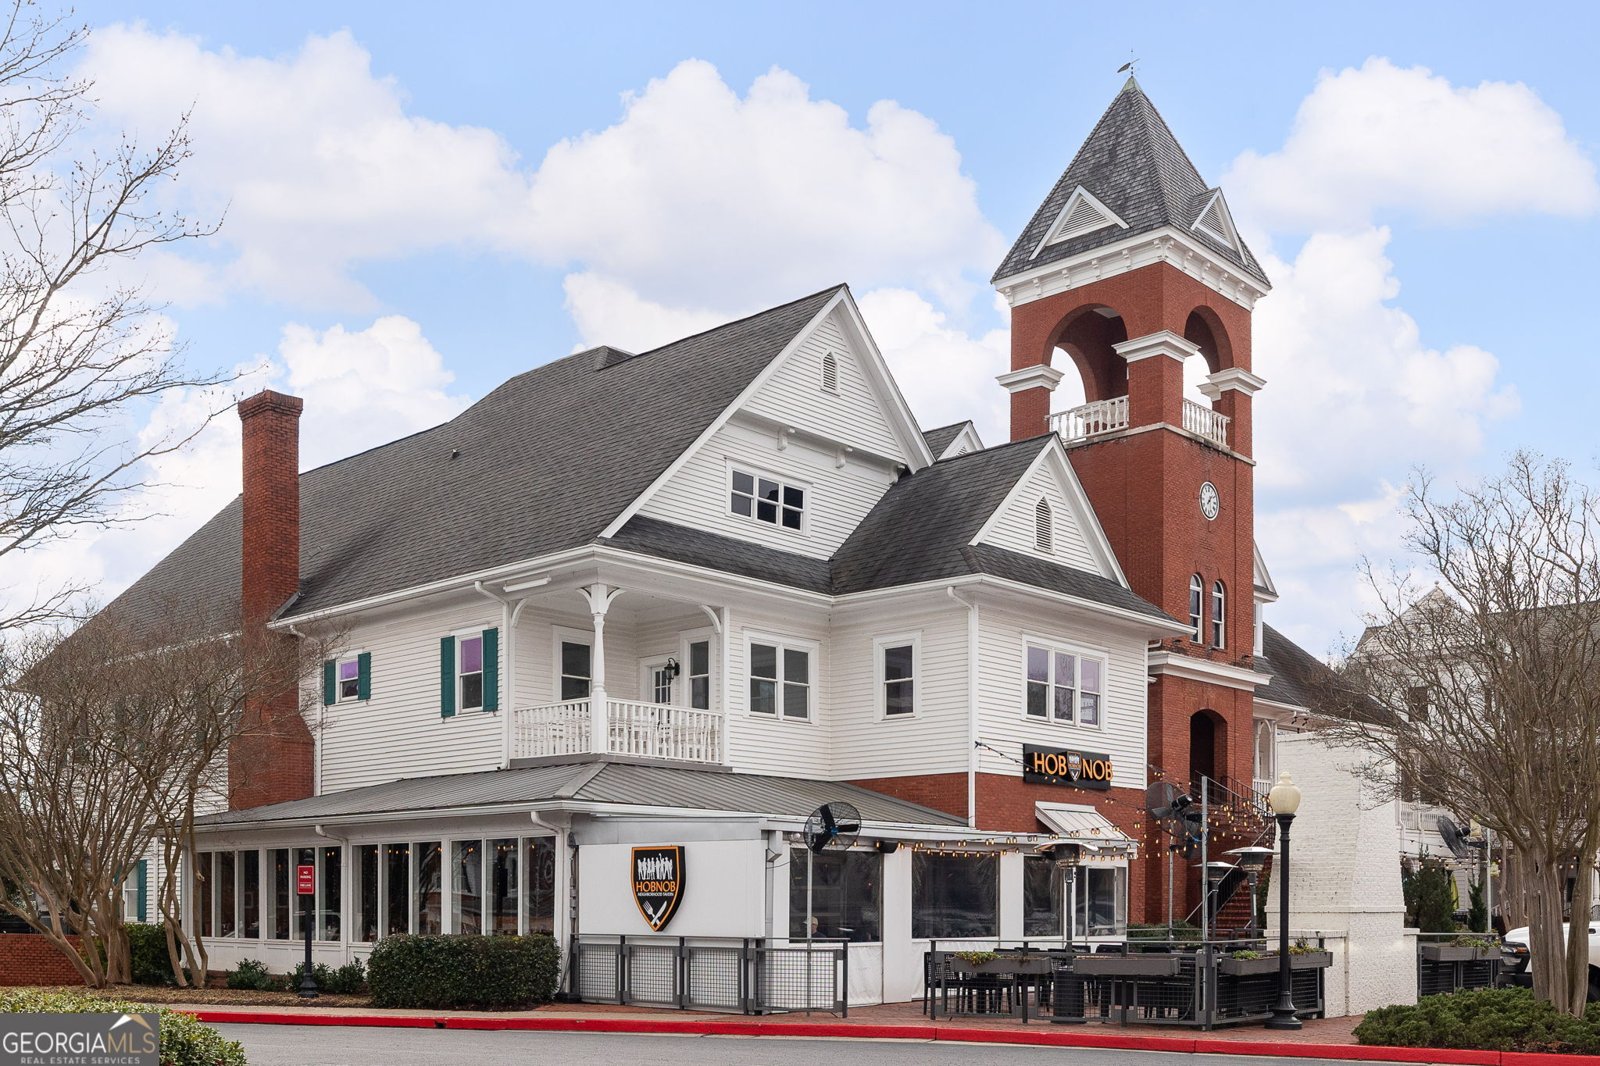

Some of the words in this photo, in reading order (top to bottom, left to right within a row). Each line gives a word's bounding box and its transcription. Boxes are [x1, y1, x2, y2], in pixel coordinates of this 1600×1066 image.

[1034, 752, 1067, 776] HOB
[1082, 758, 1113, 781] NOB
[635, 881, 676, 892] HOBNOB
